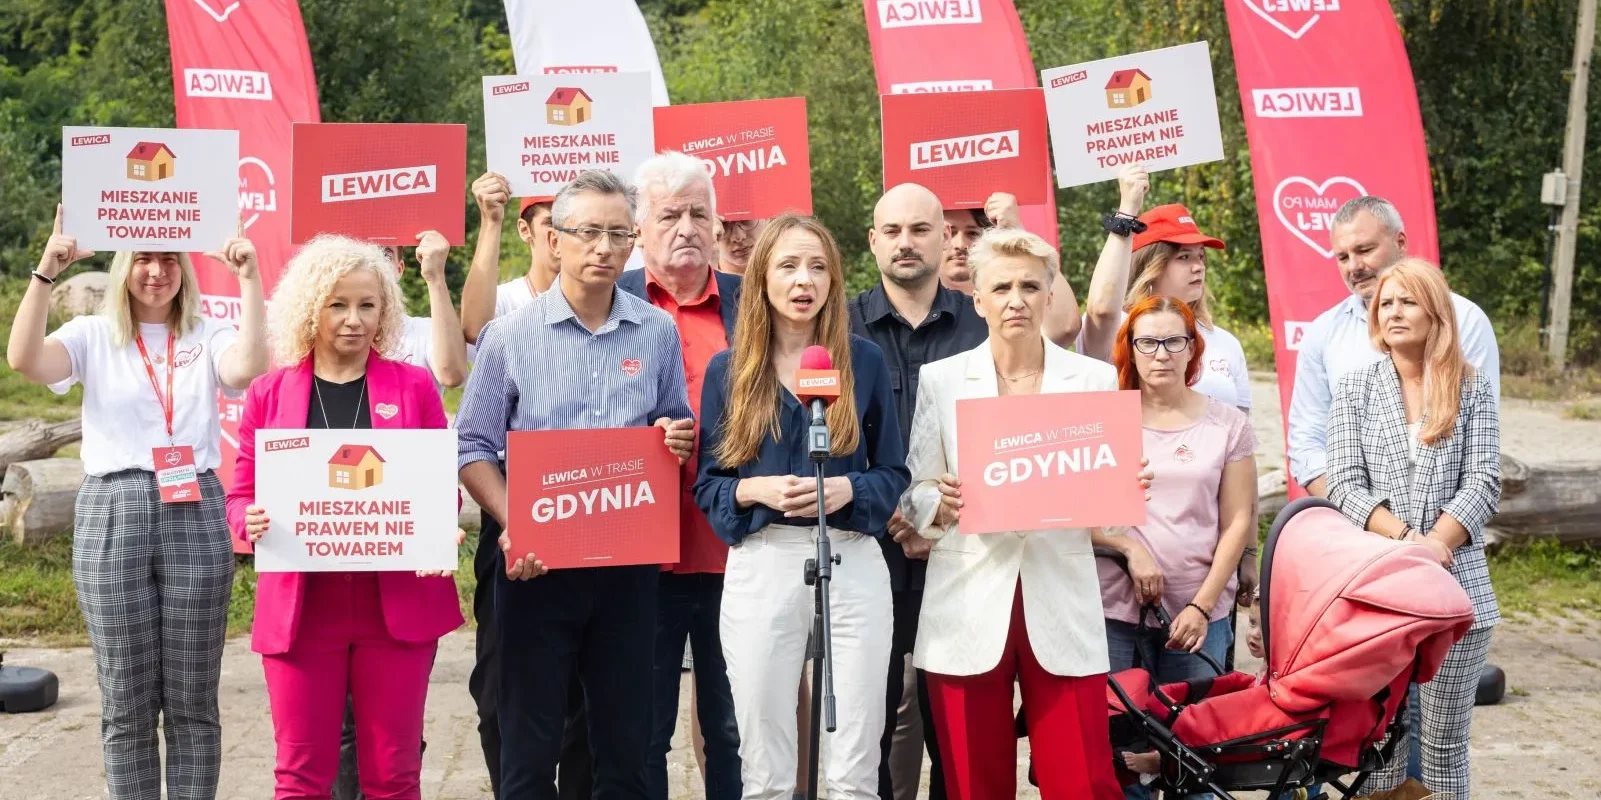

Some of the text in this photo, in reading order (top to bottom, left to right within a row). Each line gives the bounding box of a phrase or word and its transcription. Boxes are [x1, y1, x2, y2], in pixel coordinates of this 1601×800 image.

[1053, 72, 1086, 87] LEWICA
[494, 84, 528, 94] LEWICA
[1086, 109, 1179, 136] MIESZKANIE
[73, 135, 109, 146] LEWICA
[523, 134, 616, 149] MIESZKANIE
[683, 126, 775, 152] LEWICA W TRASIE
[1086, 125, 1184, 154] PRAWEM NIE
[916, 136, 1014, 165] LEWICA
[1097, 143, 1178, 168] TOWAREM
[521, 151, 620, 167] PRAWEM NIE
[702, 145, 787, 179] DYNIA
[329, 170, 431, 197] LEWICA
[101, 190, 198, 204] MIESZKANIE
[97, 208, 201, 221] PRAWEM NIE
[106, 225, 191, 239] TOWAREM
[993, 423, 1103, 450] LEWICA W TRASIE
[267, 440, 307, 451] LEWICA
[542, 459, 645, 486] LEWICA W TRASIE
[983, 443, 1117, 487] GDYNIA
[299, 501, 411, 516] MIESZKANIE
[531, 481, 655, 524] GDYNIA
[296, 521, 414, 536] PRAWEM NIE
[306, 541, 403, 556] TOWAREM
